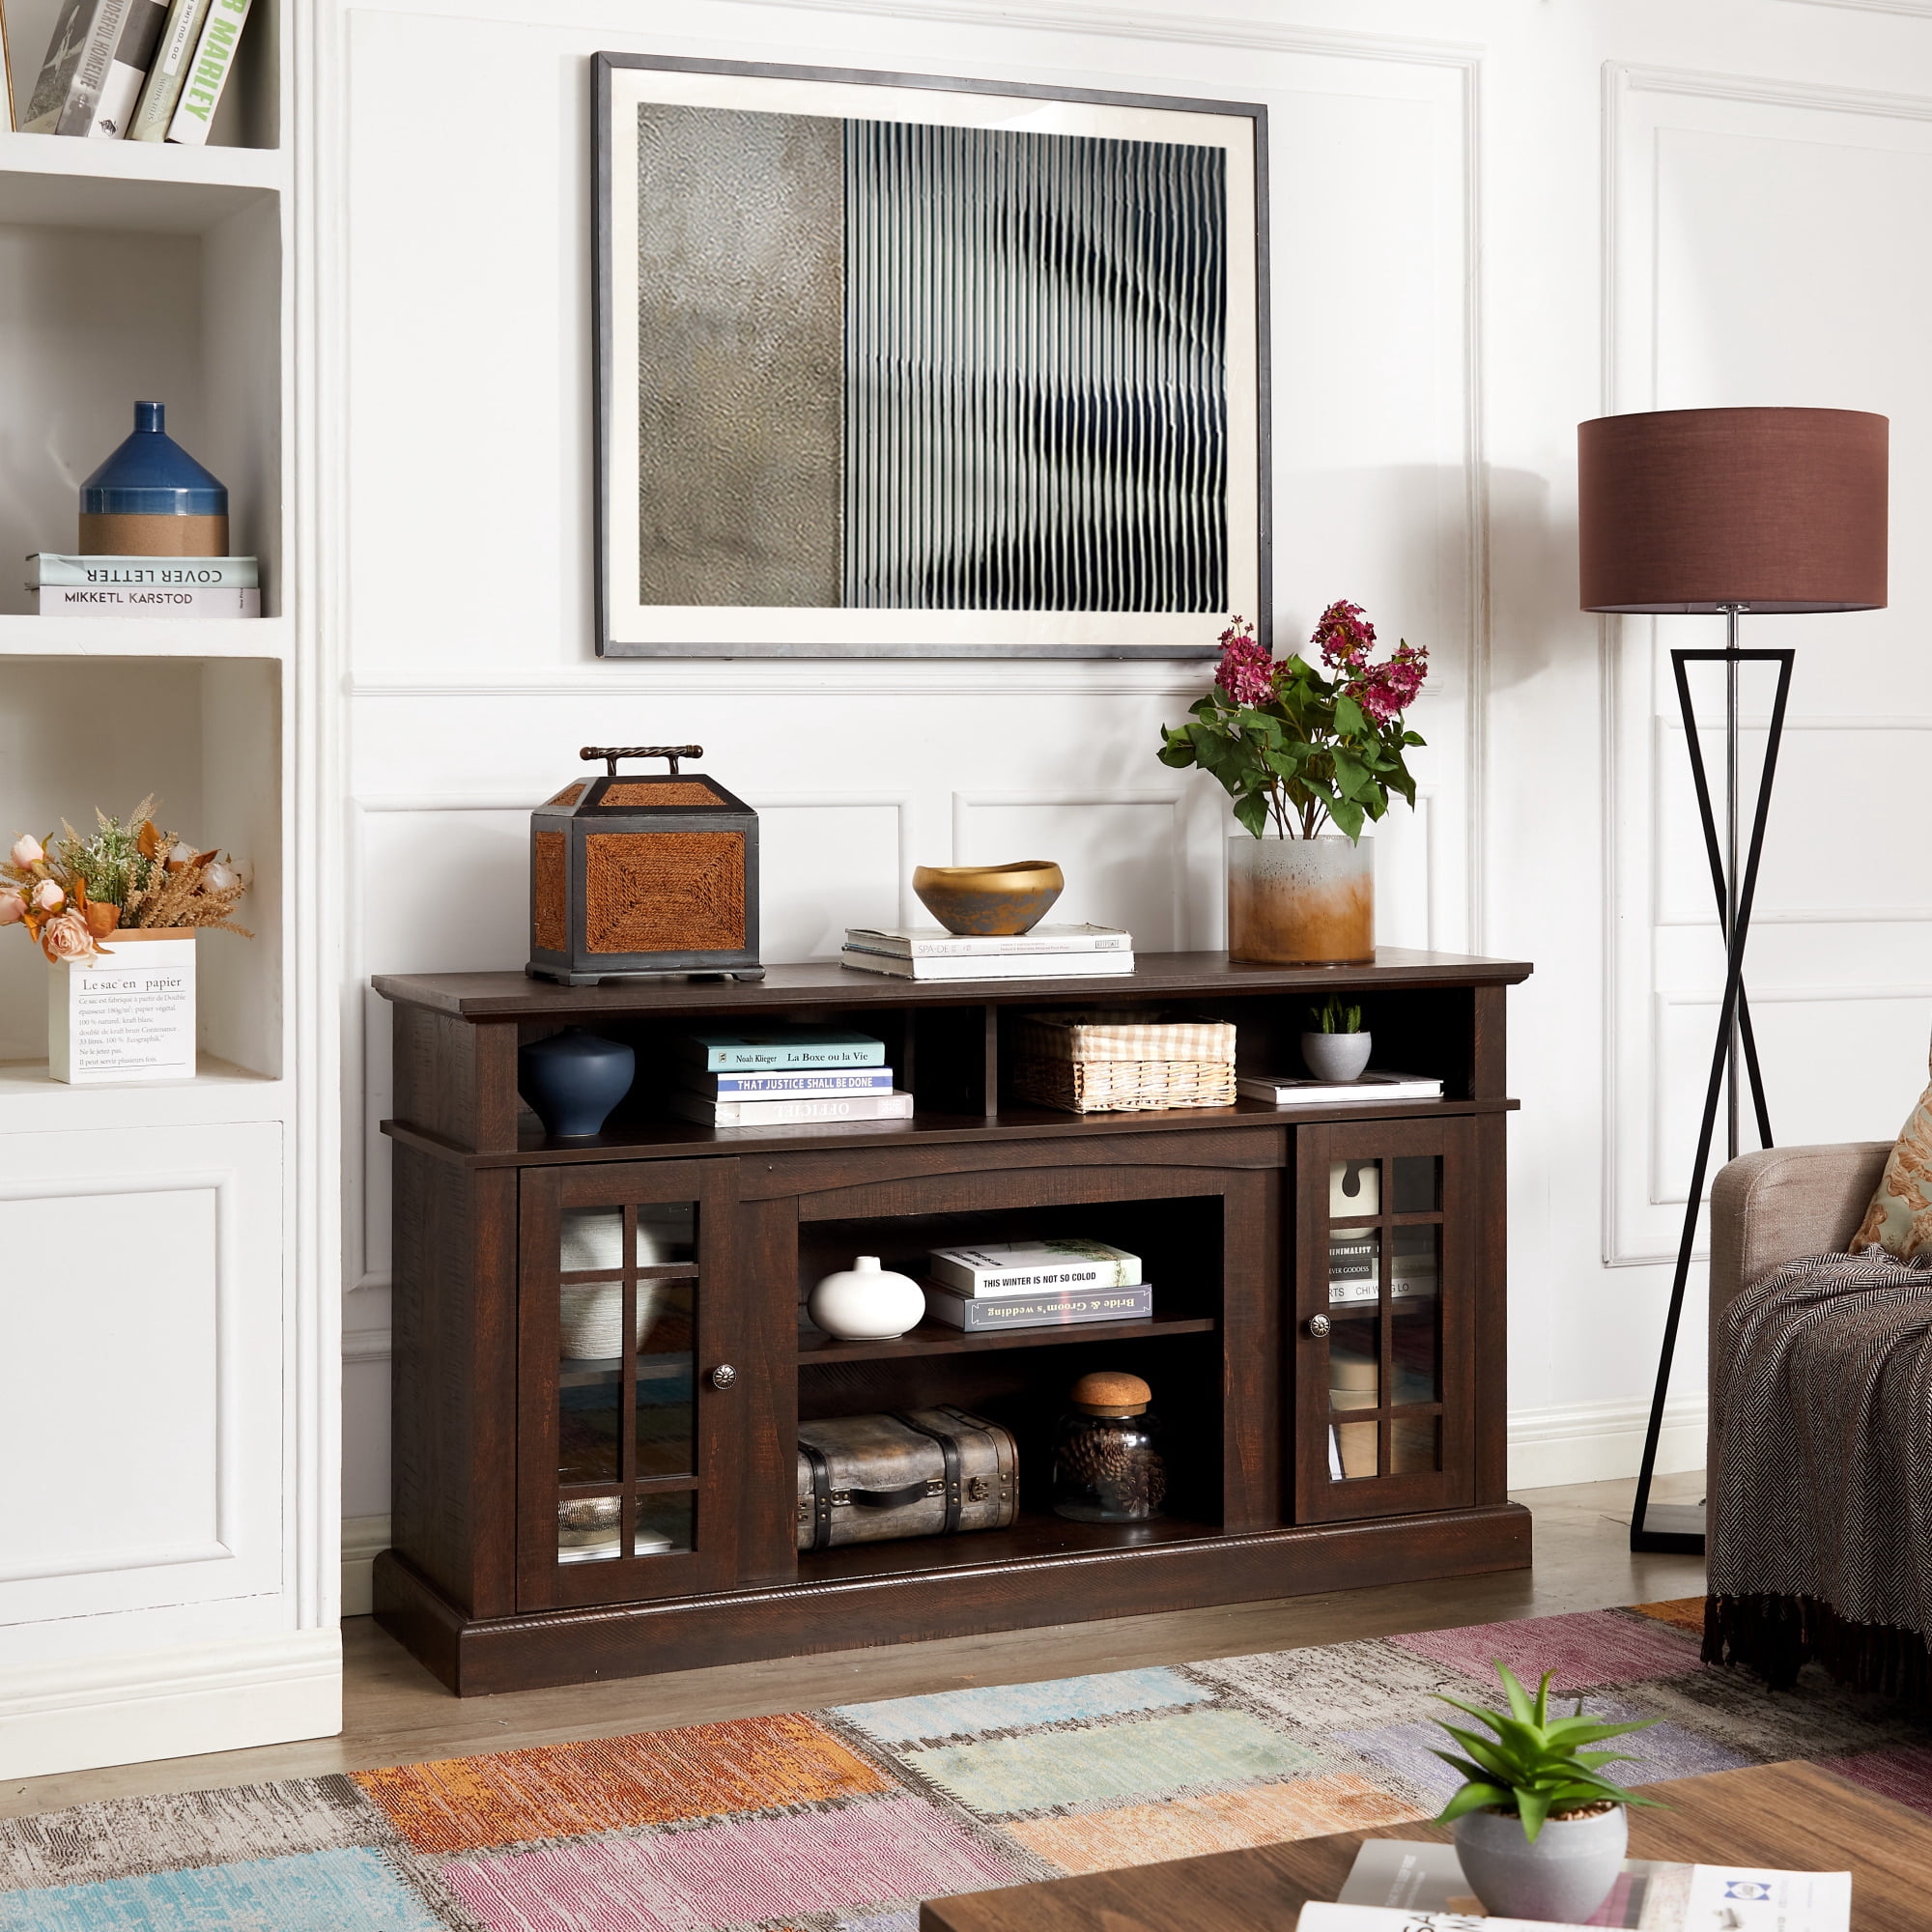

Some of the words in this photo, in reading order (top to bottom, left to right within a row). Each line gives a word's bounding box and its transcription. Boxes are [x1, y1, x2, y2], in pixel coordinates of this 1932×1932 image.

[171, 46, 180, 60] DO
[177, 26, 187, 43] YOU
[184, 5, 194, 24] LIKE
[80, 40, 110, 90] HOMELIFE
[185, 17, 239, 123] MARLEY
[87, 570, 155, 582] LETTER
[161, 570, 222, 582] COVER
[65, 592, 124, 603] MIKKETL
[129, 592, 193, 605] KARSTOD
[83, 979, 98, 990] Le
[146, 977, 182, 991] papier
[754, 1055, 778, 1064] Klieger
[787, 1053, 800, 1062] La
[802, 1052, 825, 1062] Boxe
[842, 1052, 851, 1061] la
[852, 1051, 868, 1061] Vie
[737, 1079, 763, 1091] THAT
[766, 1079, 805, 1090] JUSTICE
[807, 1078, 834, 1089] SHALL
[836, 1077, 847, 1088] BE
[848, 1077, 872, 1088] DONE
[775, 1102, 849, 1118] OFFICIEL
[983, 1279, 1001, 1289] THIS
[1002, 1276, 1032, 1287] WINTER
[1033, 1275, 1041, 1285] IS
[1042, 1274, 1059, 1284] NOT
[1060, 1272, 1070, 1283] SO
[1071, 1271, 1096, 1282] COLOD
[1355, 1286, 1371, 1295] CHI
[1397, 1283, 1409, 1293] LO
[1037, 1301, 1087, 1314] Groom's
[1091, 1299, 1101, 1311] &
[1104, 1297, 1135, 1308] Bride
[987, 1304, 1034, 1318] wedding
